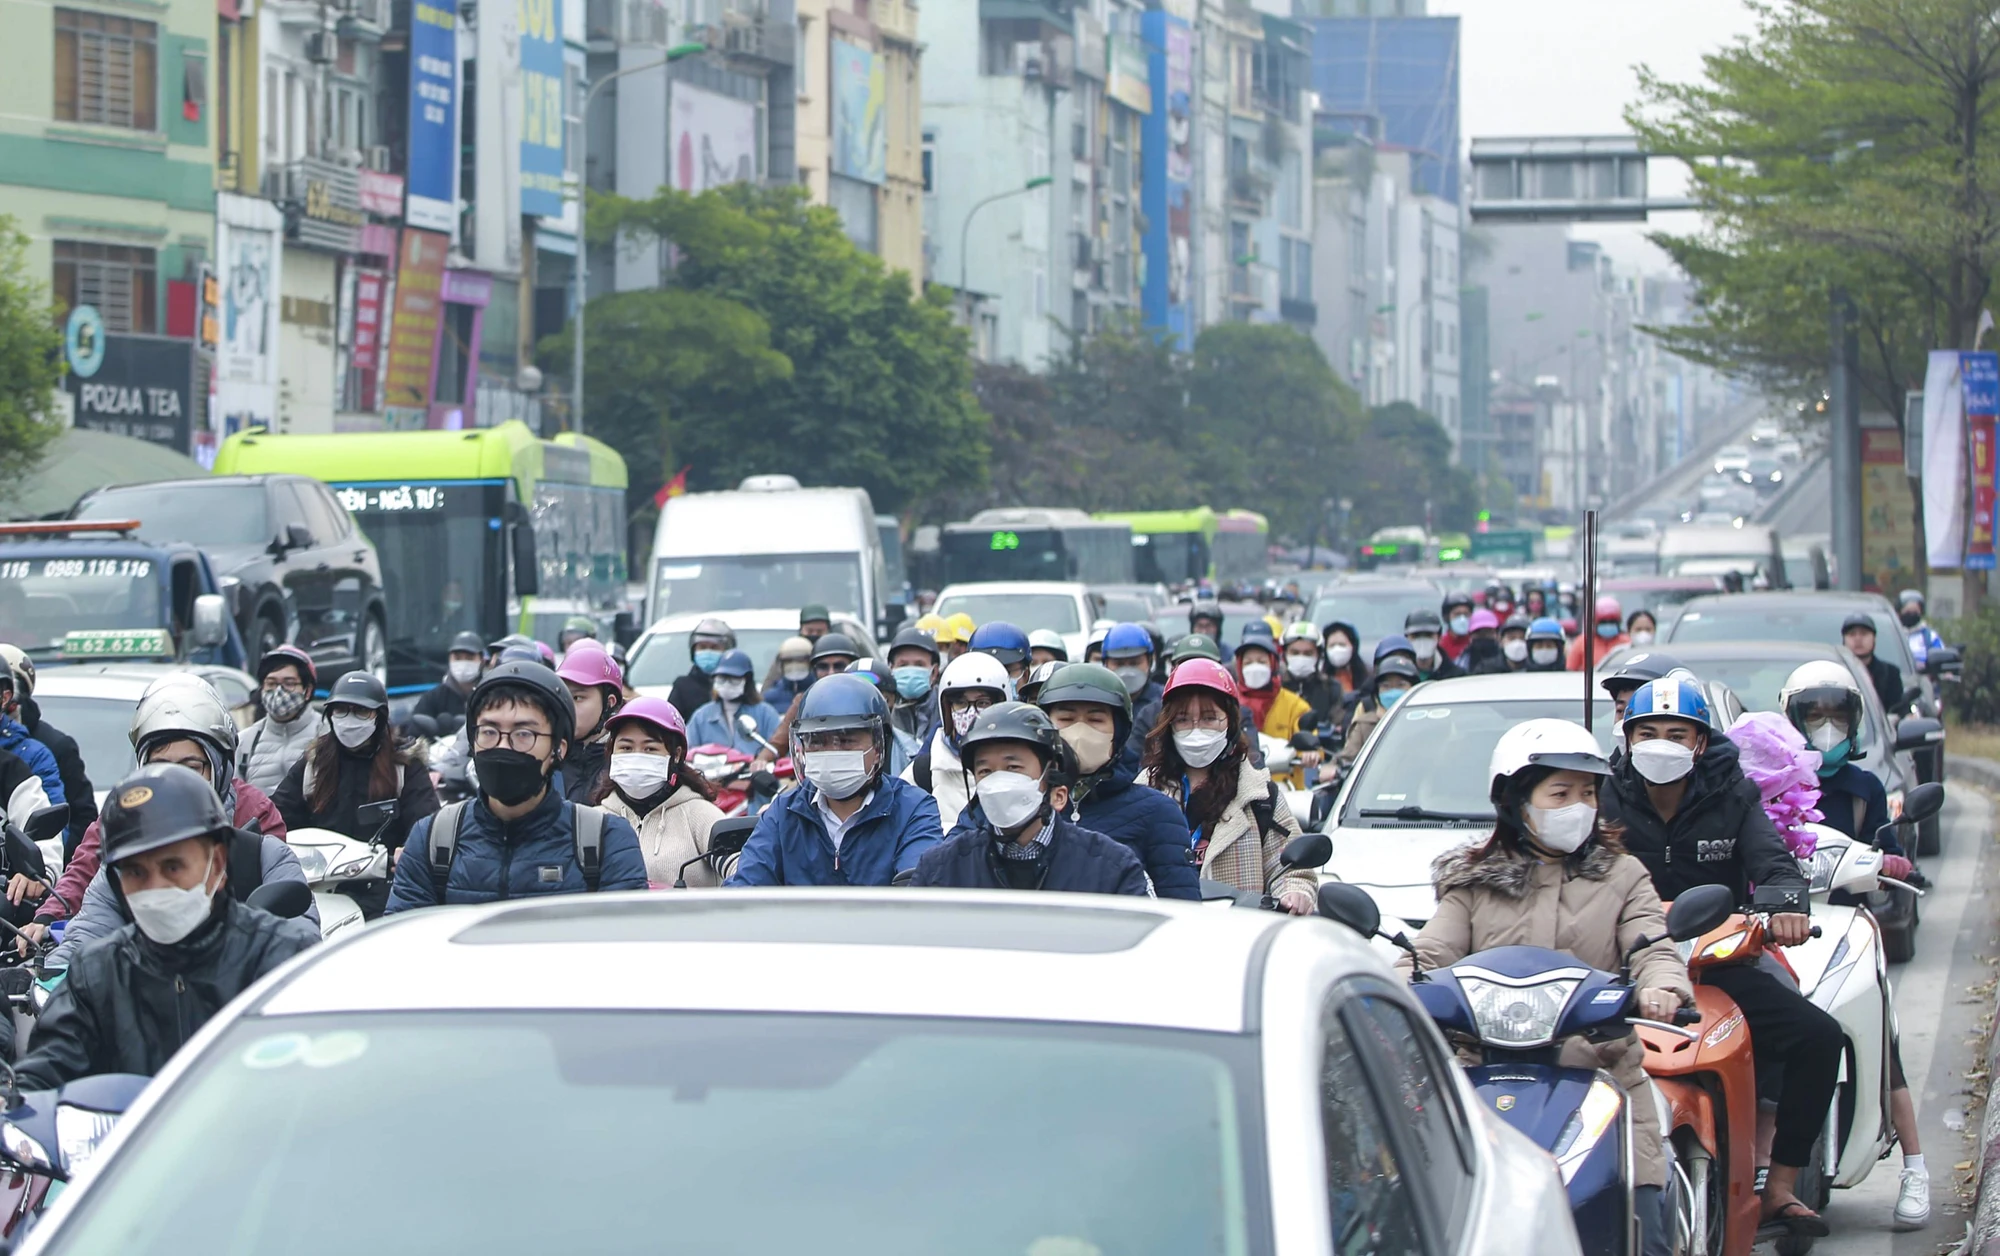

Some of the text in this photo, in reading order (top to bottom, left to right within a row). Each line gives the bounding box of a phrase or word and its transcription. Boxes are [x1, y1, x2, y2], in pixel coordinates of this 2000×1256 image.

[81, 383, 181, 416] POZAA TEA
[2, 560, 150, 579] 116 0989 116 116
[1697, 852, 1732, 862] LANDS
